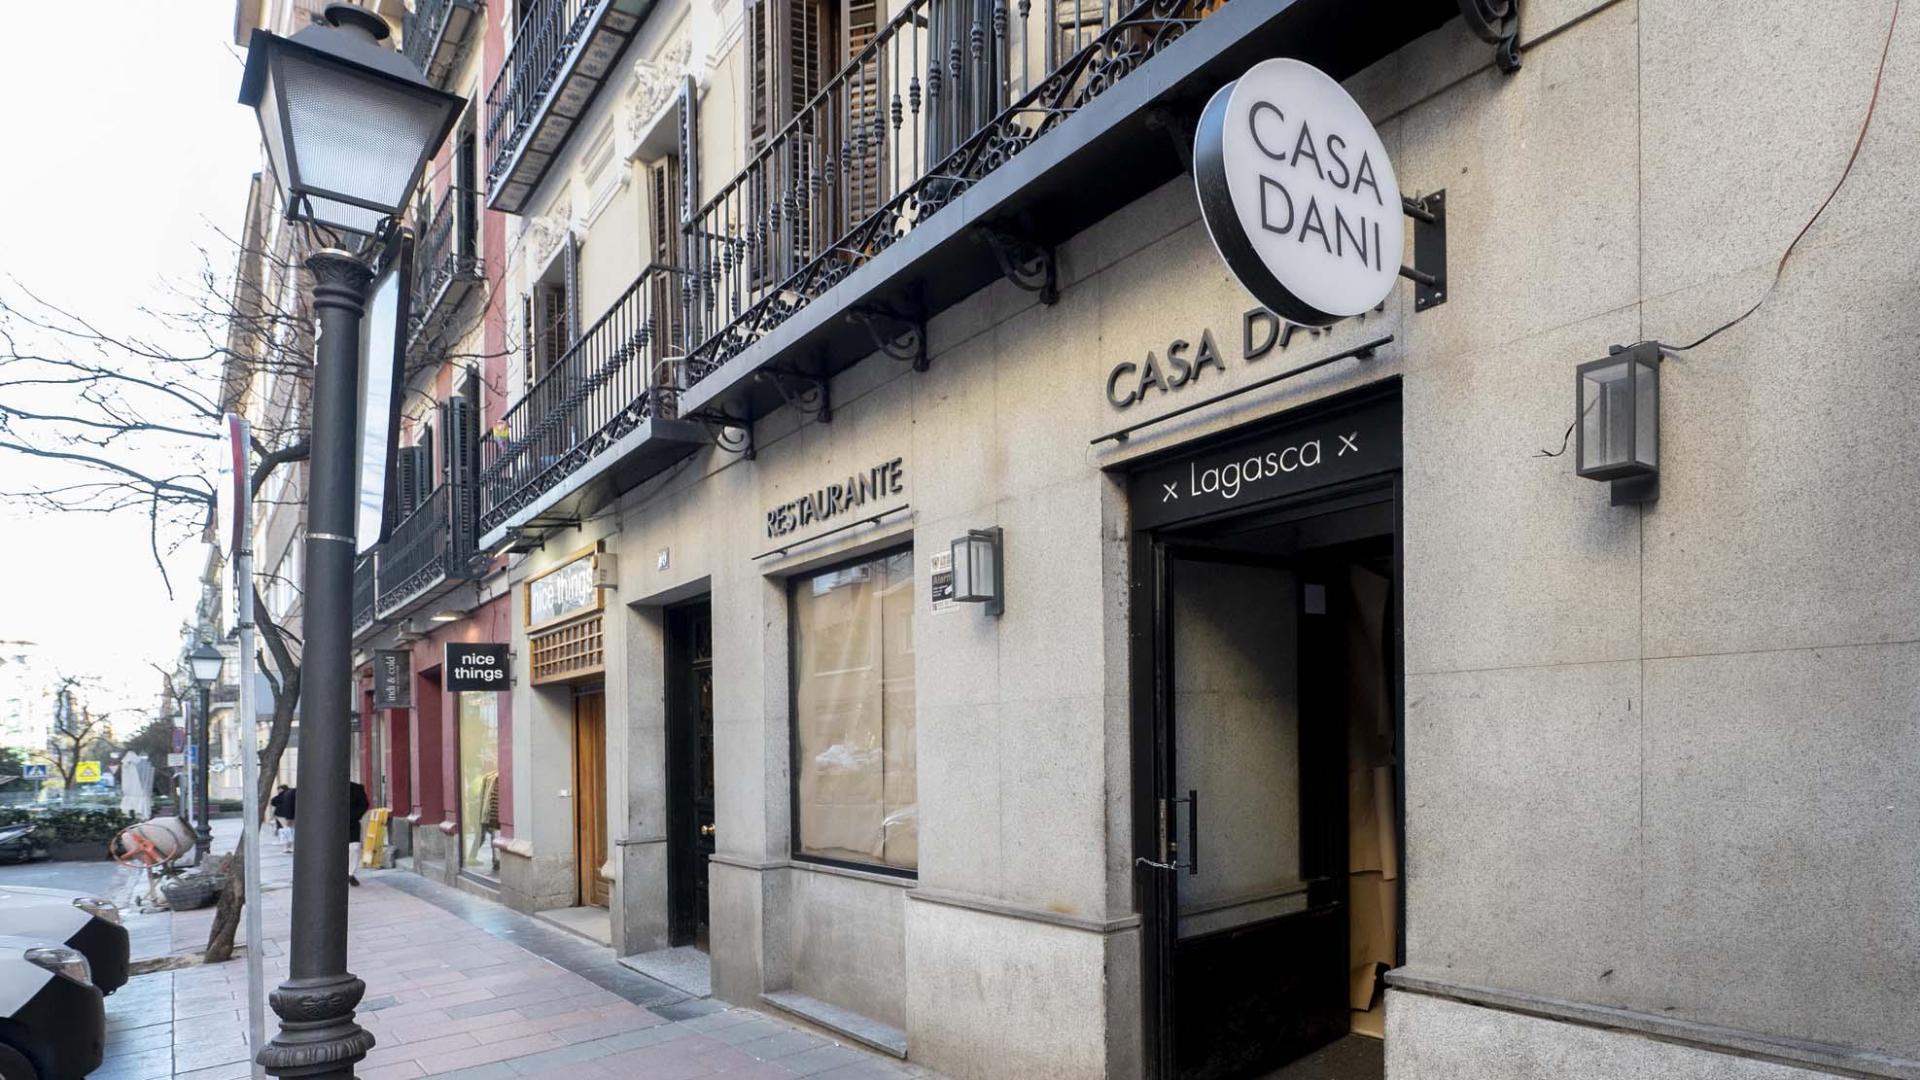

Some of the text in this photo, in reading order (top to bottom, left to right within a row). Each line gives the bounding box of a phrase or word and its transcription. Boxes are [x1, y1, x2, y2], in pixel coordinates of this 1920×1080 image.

[1248, 100, 1384, 207] CASA
[1258, 173, 1382, 272] DANI
[1106, 327, 1226, 408] CASA
[767, 456, 903, 539] RESTAURANTE
[1190, 439, 1321, 499] Lagasca
[454, 666, 504, 682] things
[461, 652, 496, 666] nice
